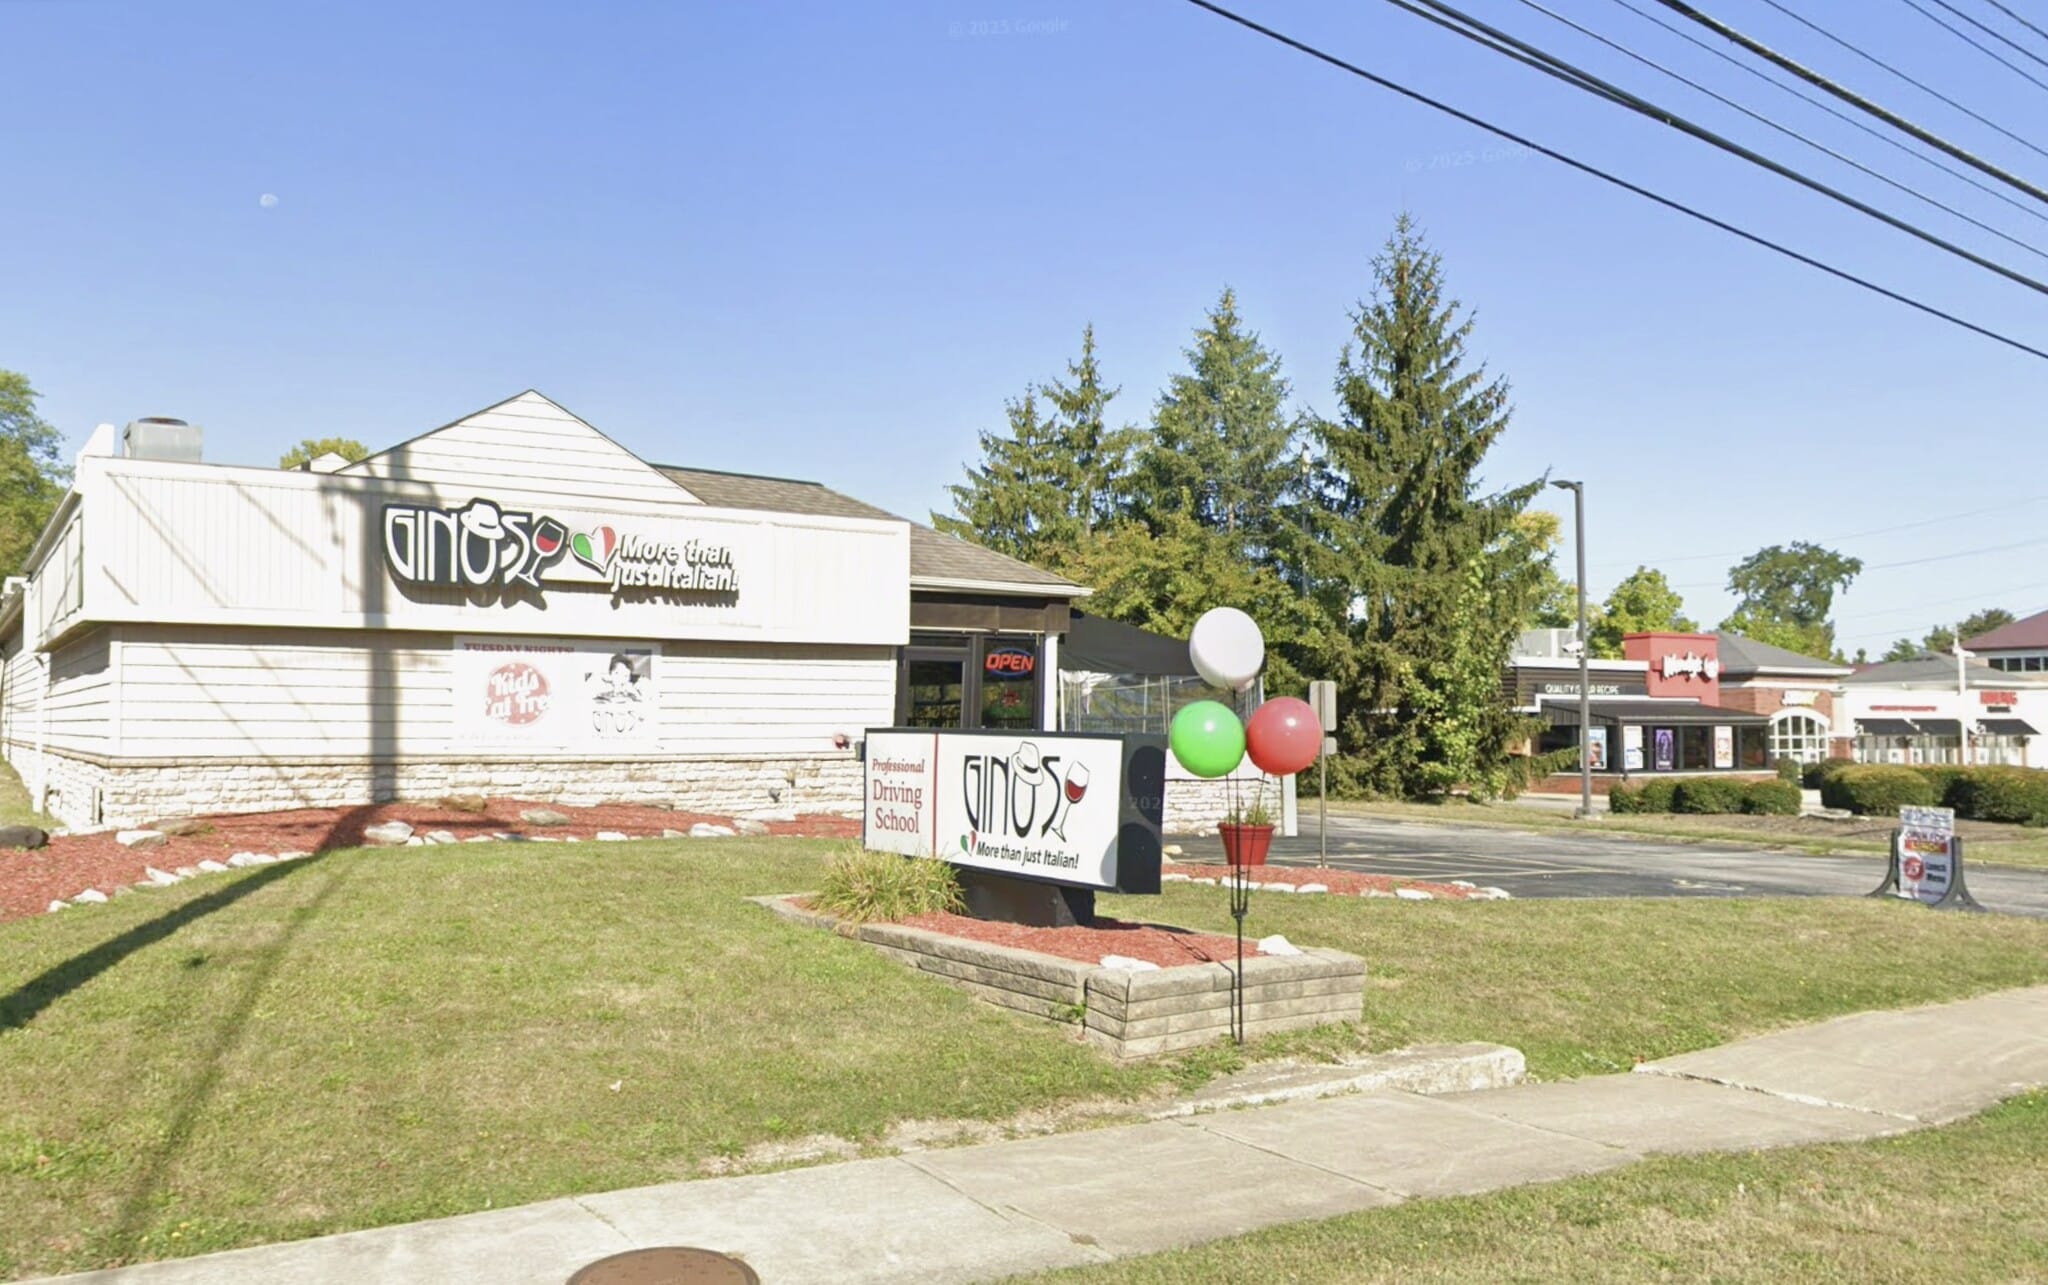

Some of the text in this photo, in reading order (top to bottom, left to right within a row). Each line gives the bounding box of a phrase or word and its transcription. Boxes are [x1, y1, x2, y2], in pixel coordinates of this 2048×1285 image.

[621, 534, 733, 567] More than
[662, 565, 740, 591] Italian!
[464, 642, 521, 654] TUESDAY
[986, 653, 1034, 671] OPEN
[490, 670, 540, 697] Kids
[514, 691, 551, 714] Fre
[872, 757, 925, 776] Professional
[873, 779, 923, 810] Driving
[875, 806, 919, 833] School
[976, 842, 1079, 869] More than just Italian!
